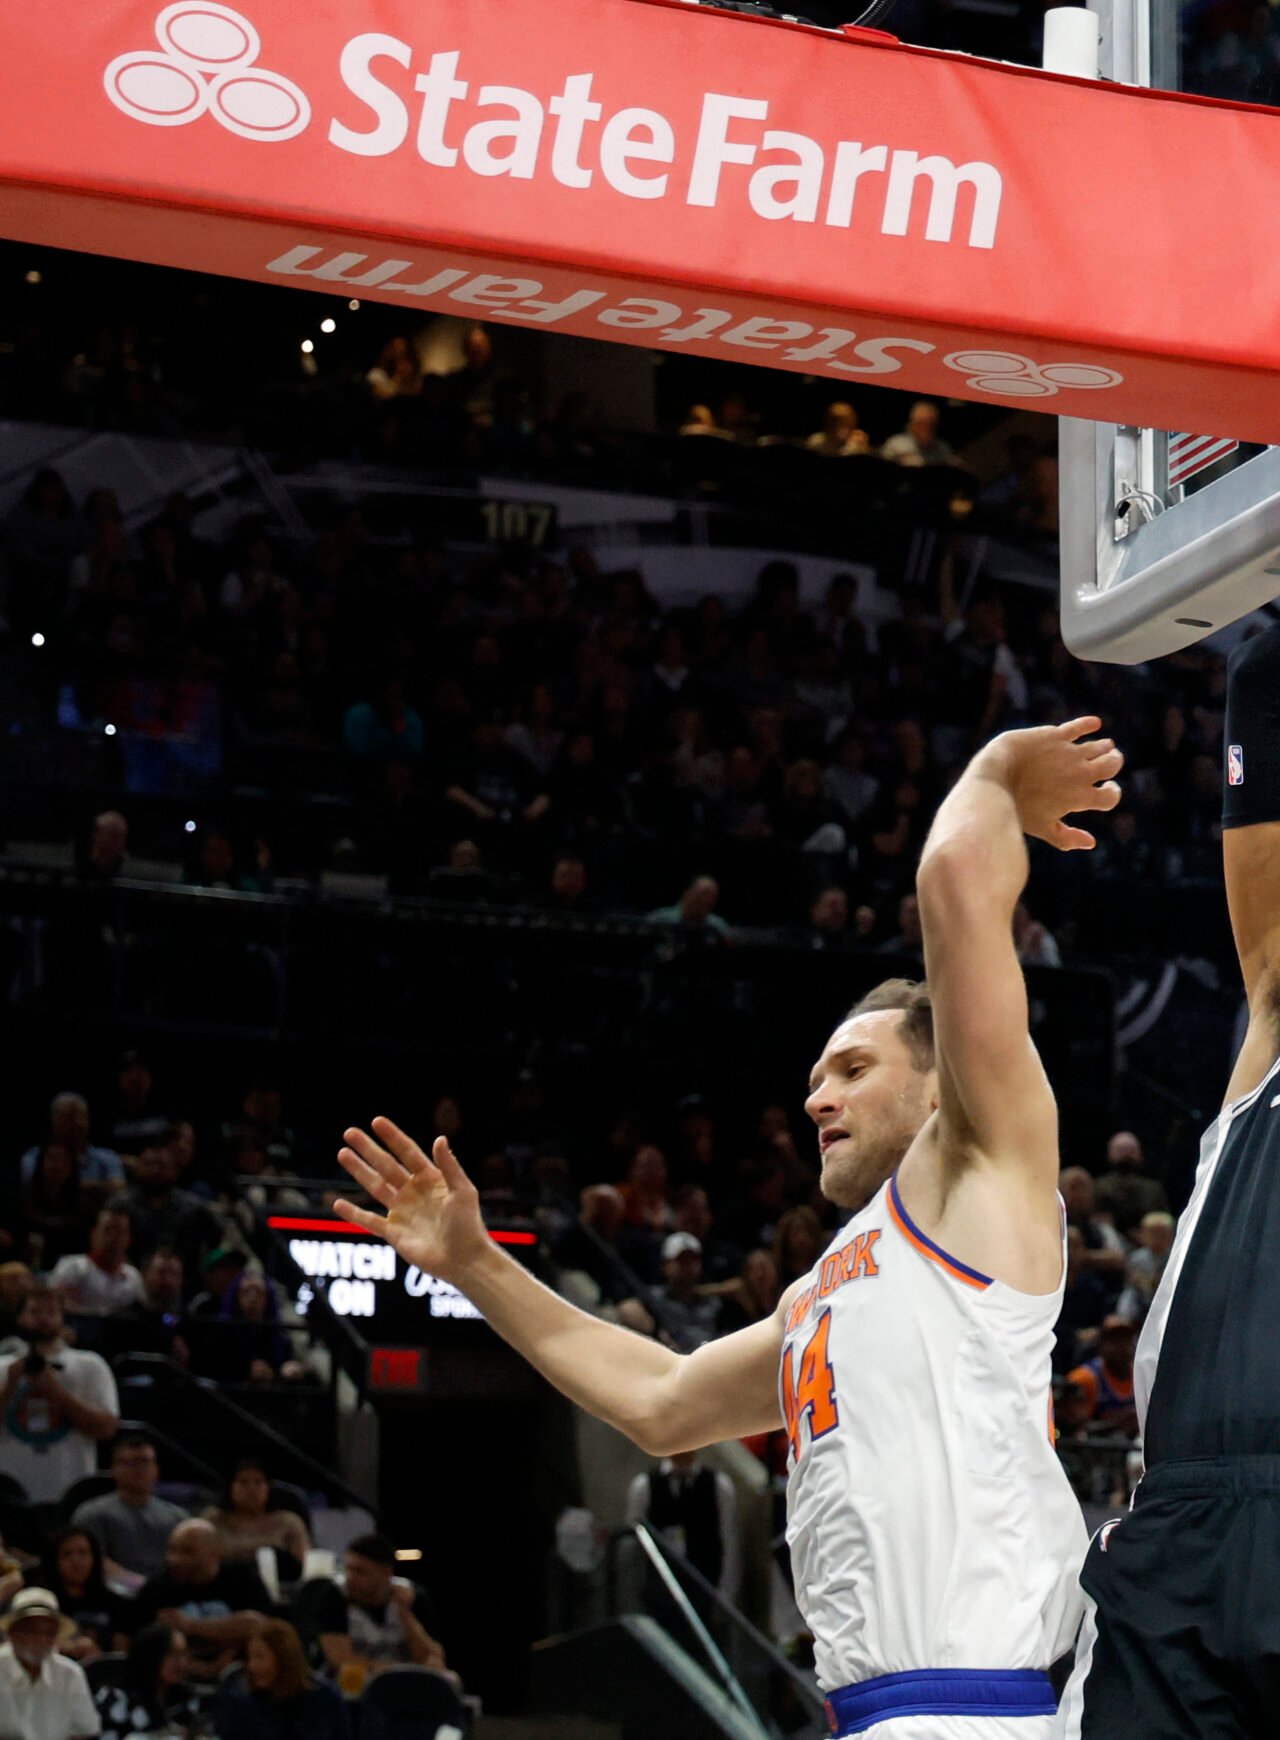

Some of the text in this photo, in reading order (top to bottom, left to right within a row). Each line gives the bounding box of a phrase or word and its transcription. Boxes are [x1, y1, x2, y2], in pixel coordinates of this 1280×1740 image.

[481, 502, 552, 546] 107
[289, 1239, 396, 1281] WATCH
[328, 1279, 375, 1317] ON
